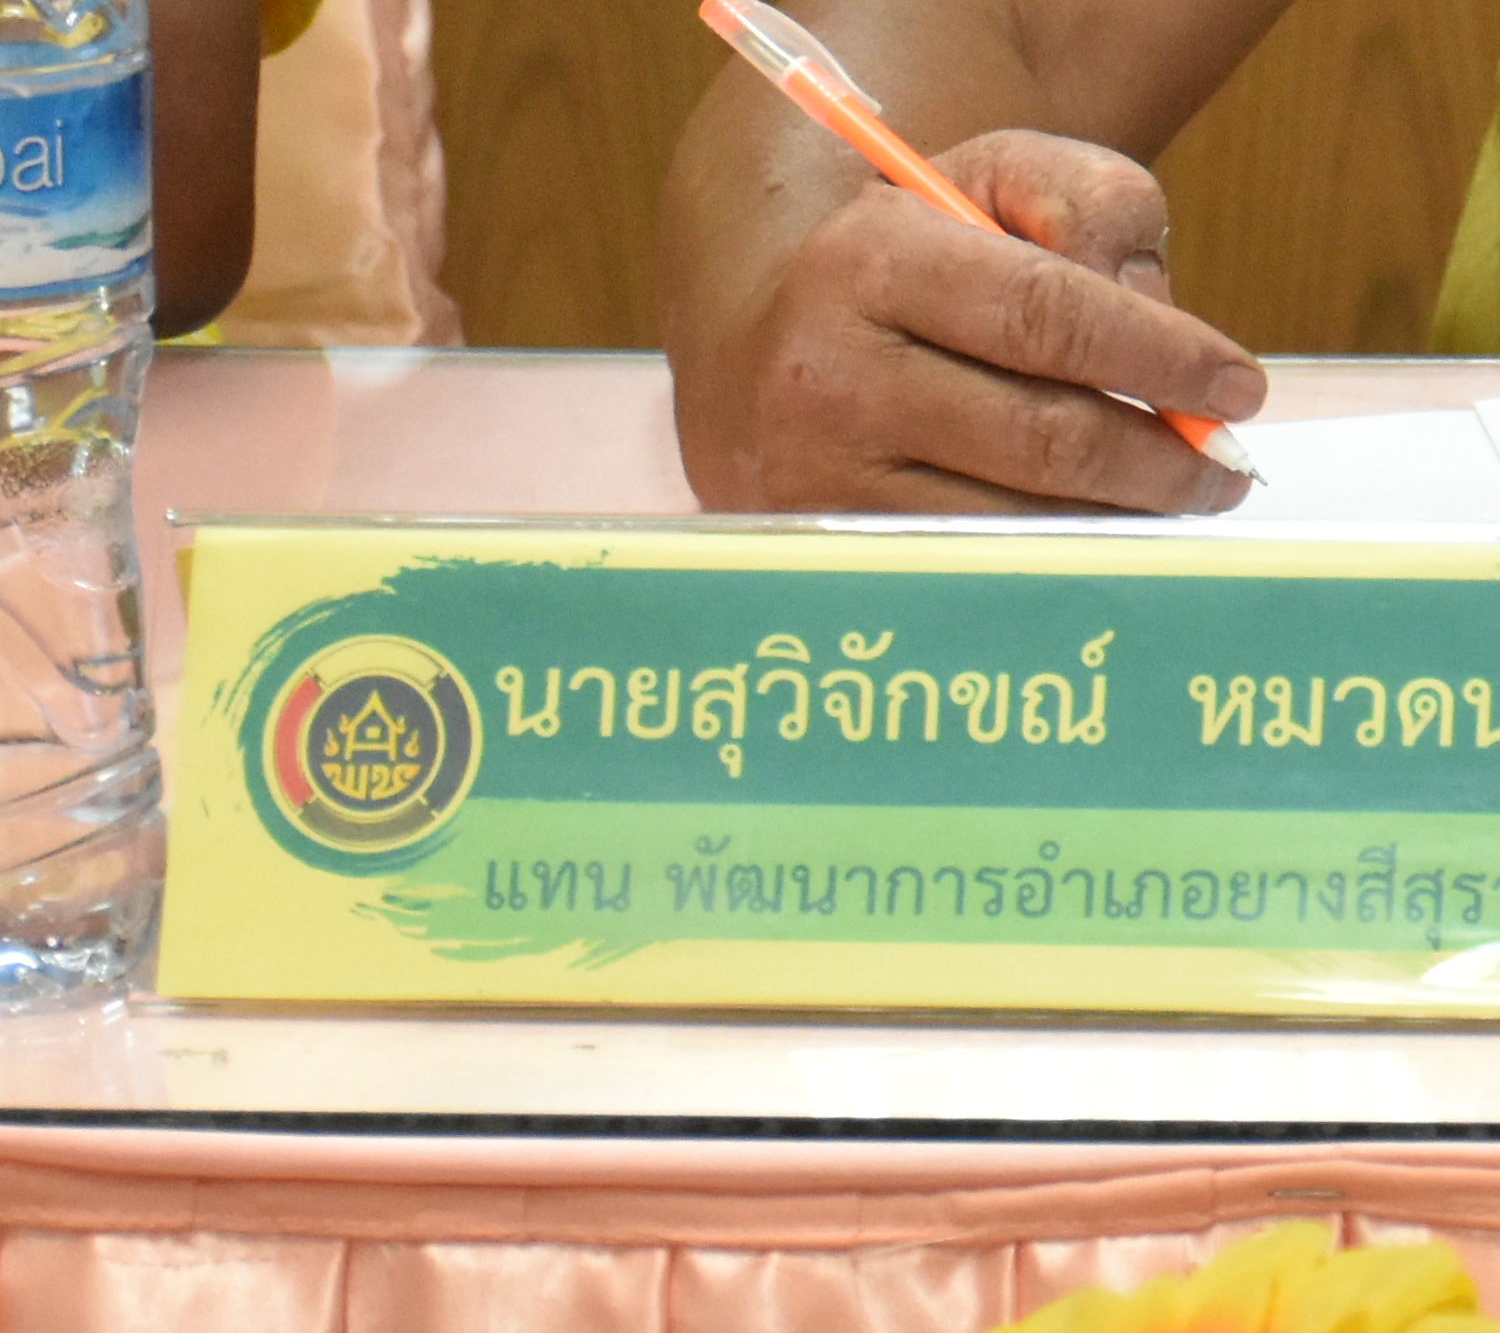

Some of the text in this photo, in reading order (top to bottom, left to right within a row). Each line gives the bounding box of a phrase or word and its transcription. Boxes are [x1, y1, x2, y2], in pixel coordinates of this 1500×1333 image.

[0, 119, 65, 192] ai
[495, 629, 1115, 778] นายสุวิจักขณ์
[485, 858, 632, 913] แทน
